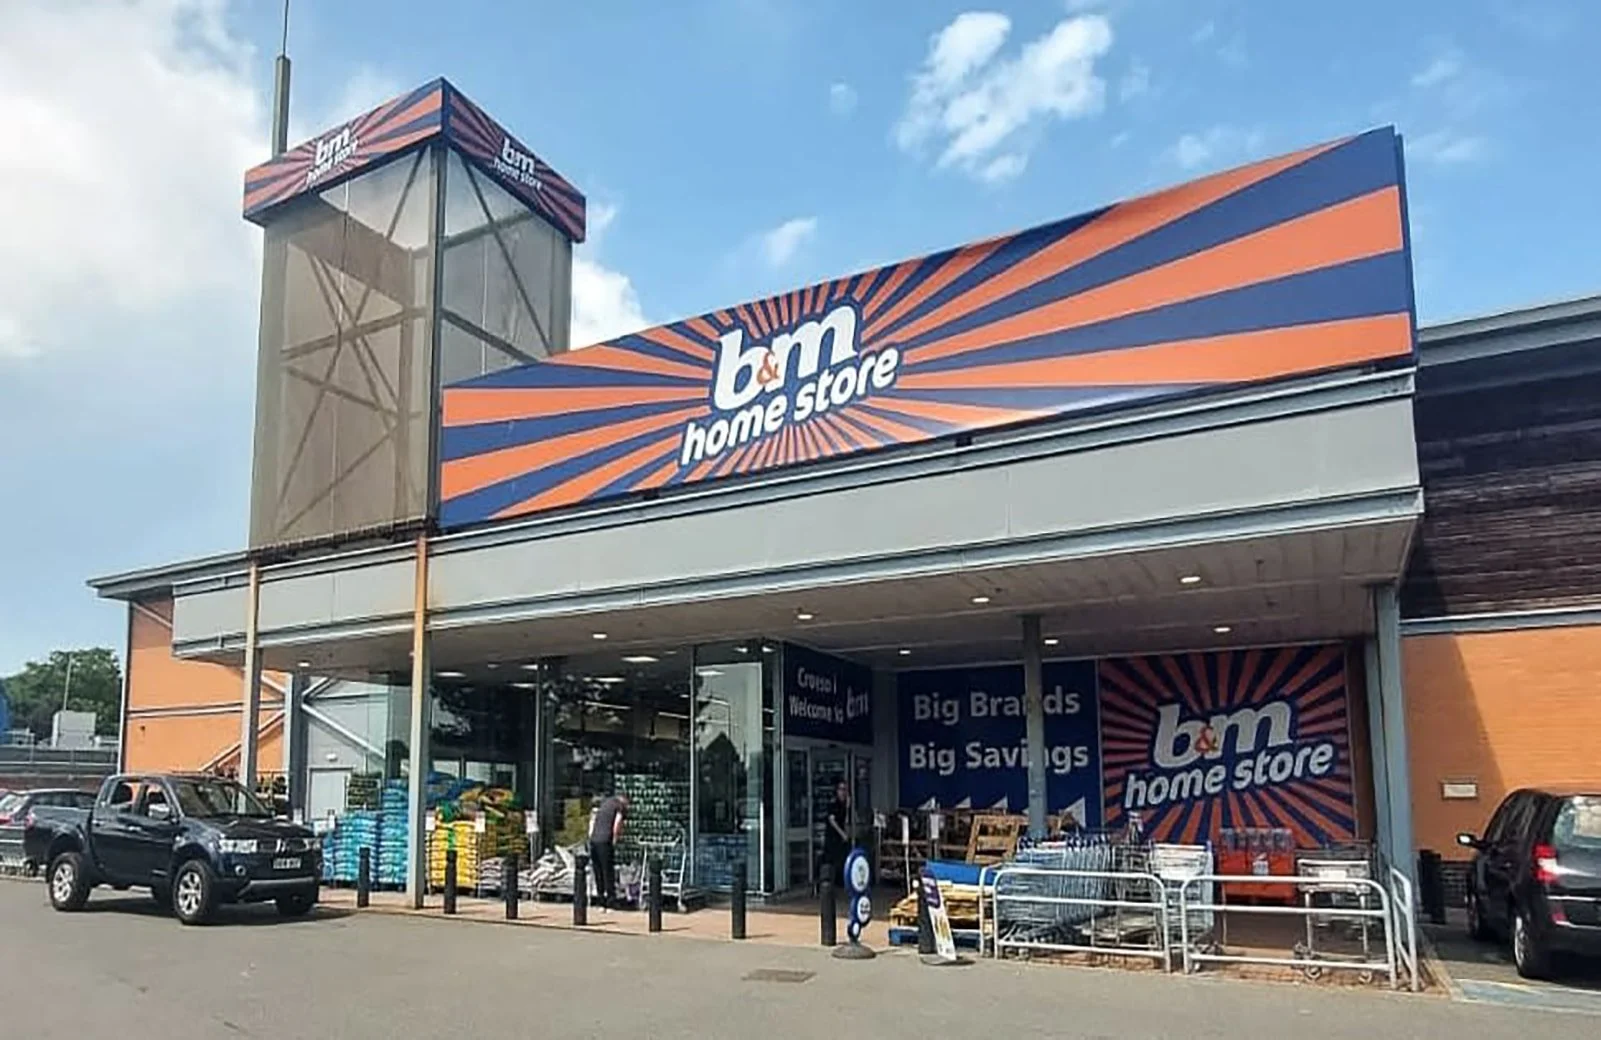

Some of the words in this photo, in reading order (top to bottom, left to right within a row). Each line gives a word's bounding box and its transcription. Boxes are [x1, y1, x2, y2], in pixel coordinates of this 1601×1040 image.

[714, 306, 858, 410] b&m
[681, 395, 787, 465] home
[793, 348, 898, 421] store
[914, 692, 960, 725] Big
[1153, 700, 1293, 768] b&m
[909, 742, 955, 775] Big
[1124, 763, 1226, 808] home
[1233, 743, 1333, 790] store
